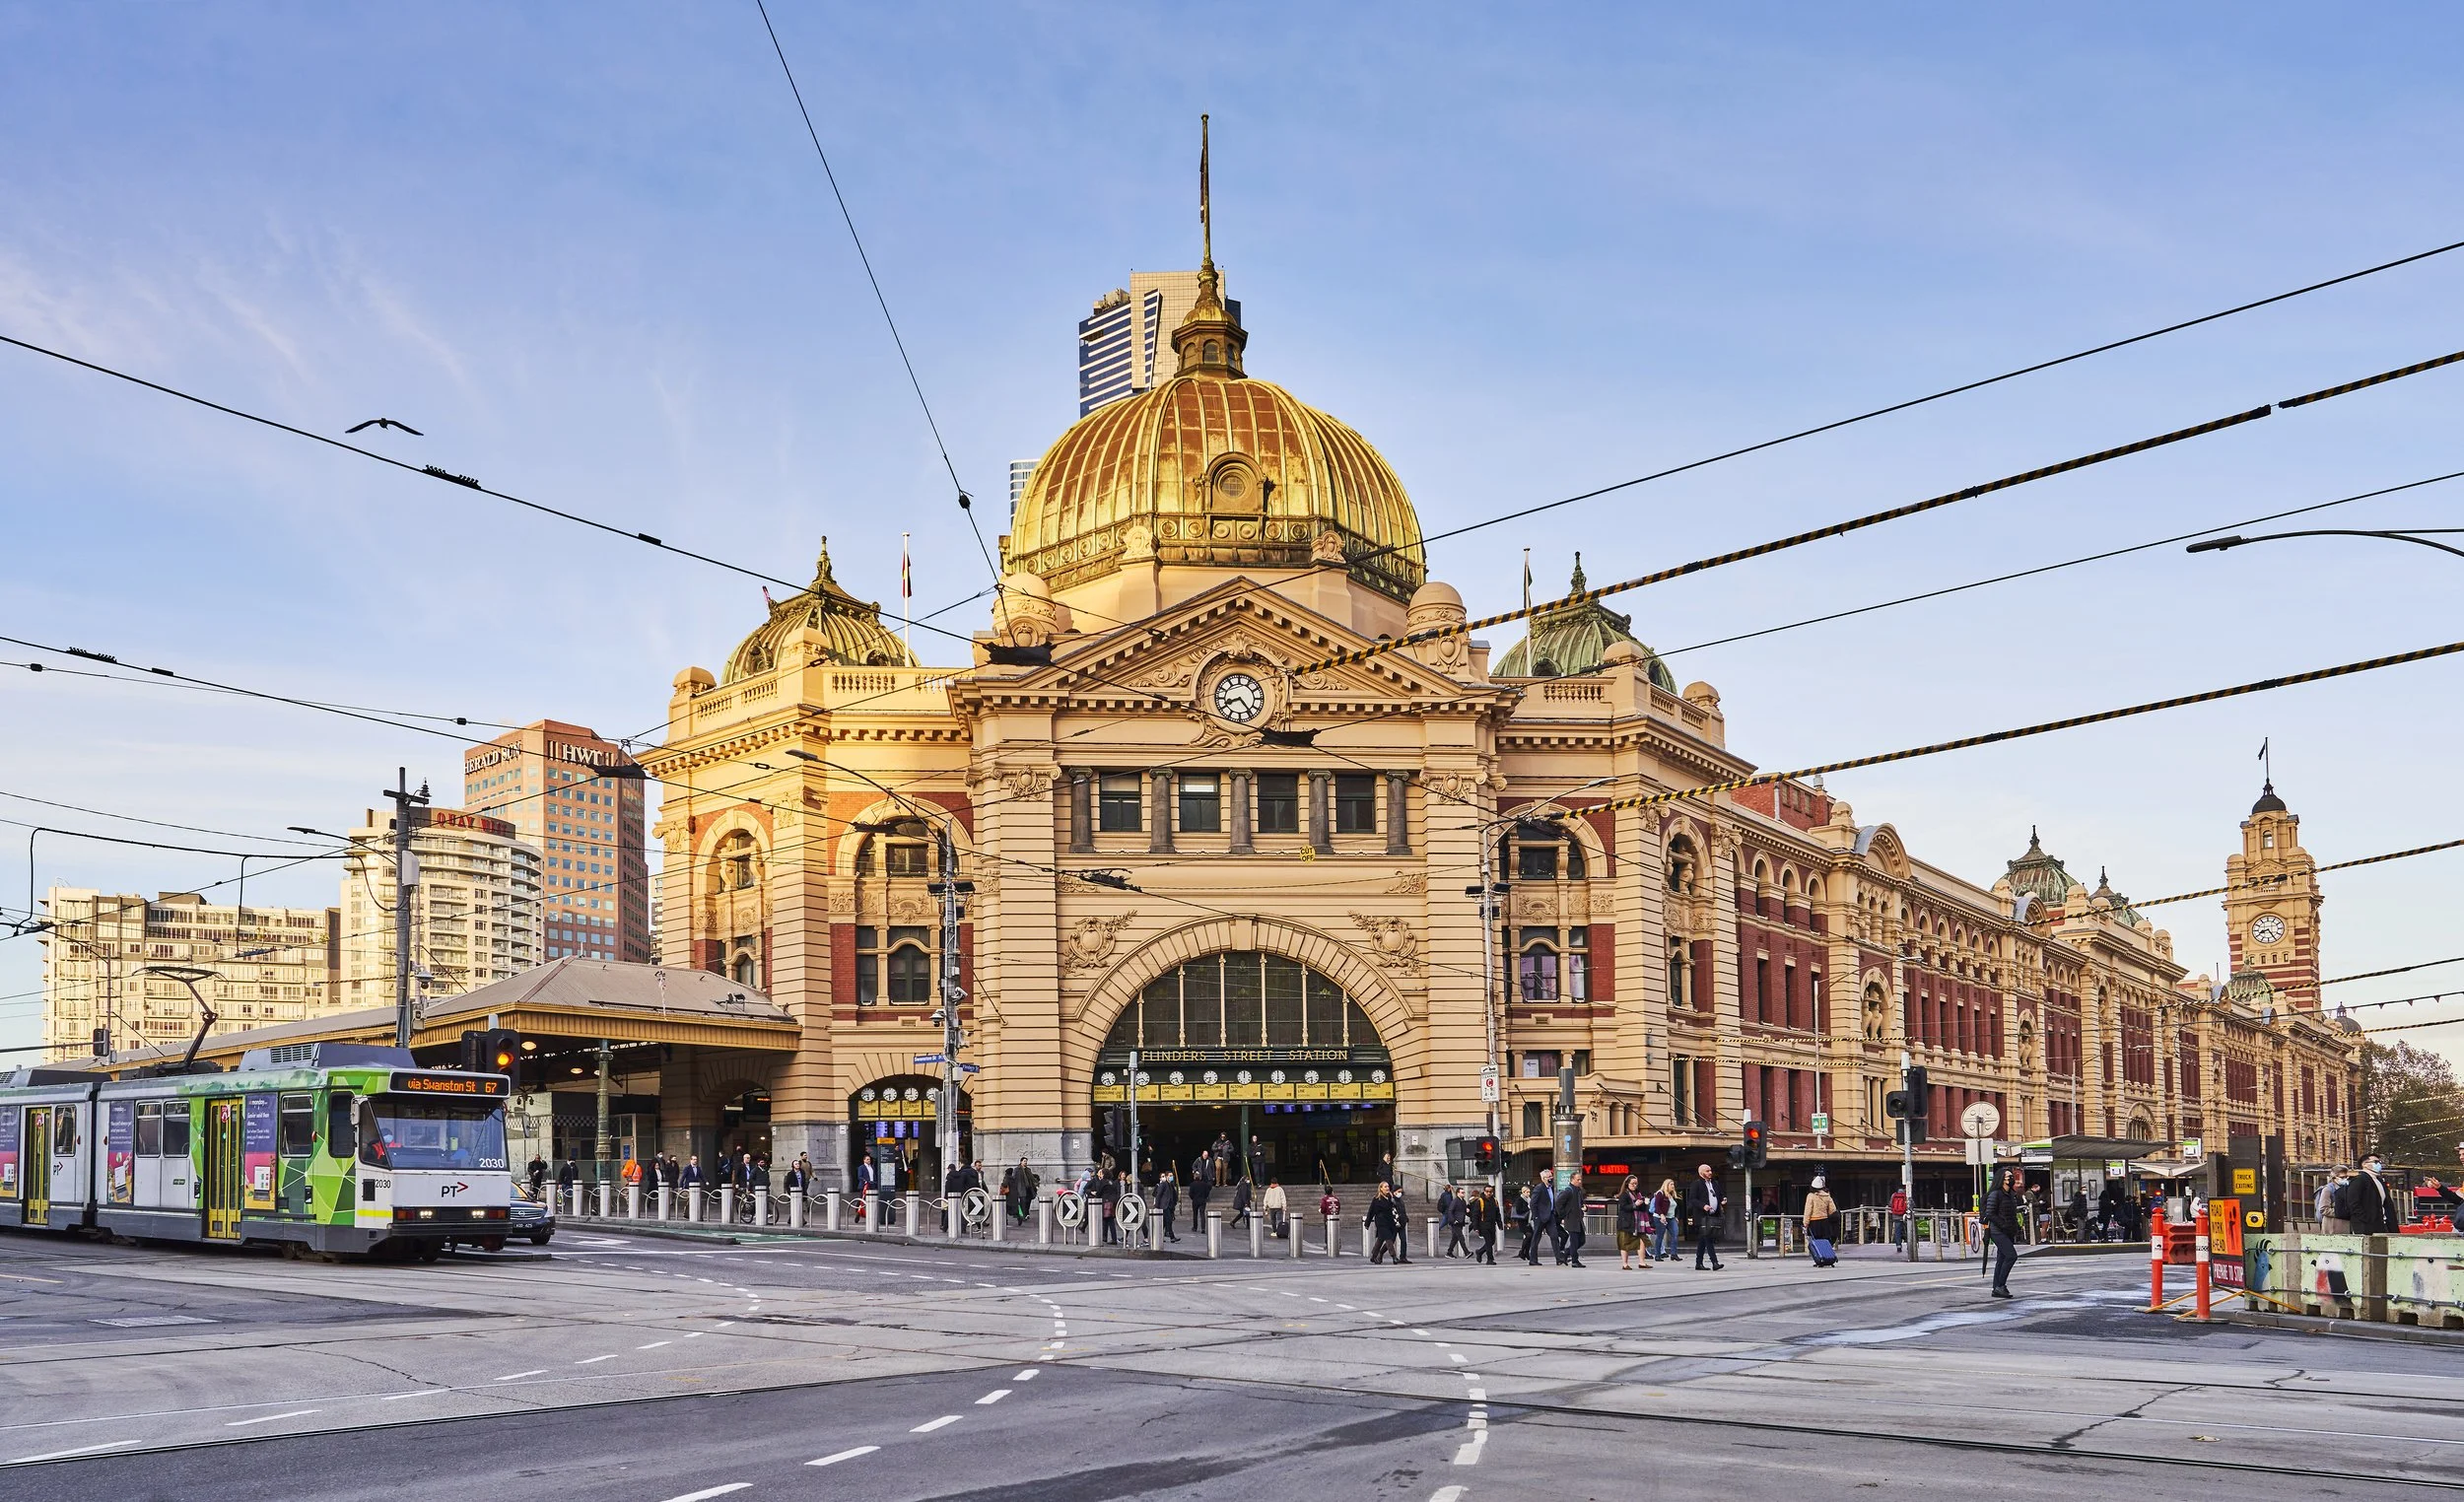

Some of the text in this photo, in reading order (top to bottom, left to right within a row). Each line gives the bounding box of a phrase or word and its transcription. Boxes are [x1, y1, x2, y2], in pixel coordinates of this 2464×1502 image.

[464, 741, 522, 775] HERALD SUN
[562, 743, 603, 766] HWT
[437, 812, 475, 828] QUAY
[1141, 1050, 1348, 1061] FLINDERS STREET STATION
[408, 1078, 497, 1093] via Swanston St 67
[478, 1158, 505, 1169] 2030
[375, 1179, 391, 1189] 2030
[2211, 1204, 2223, 1217] ROAD
[2214, 1263, 2243, 1282] PREPARE TO STOP
